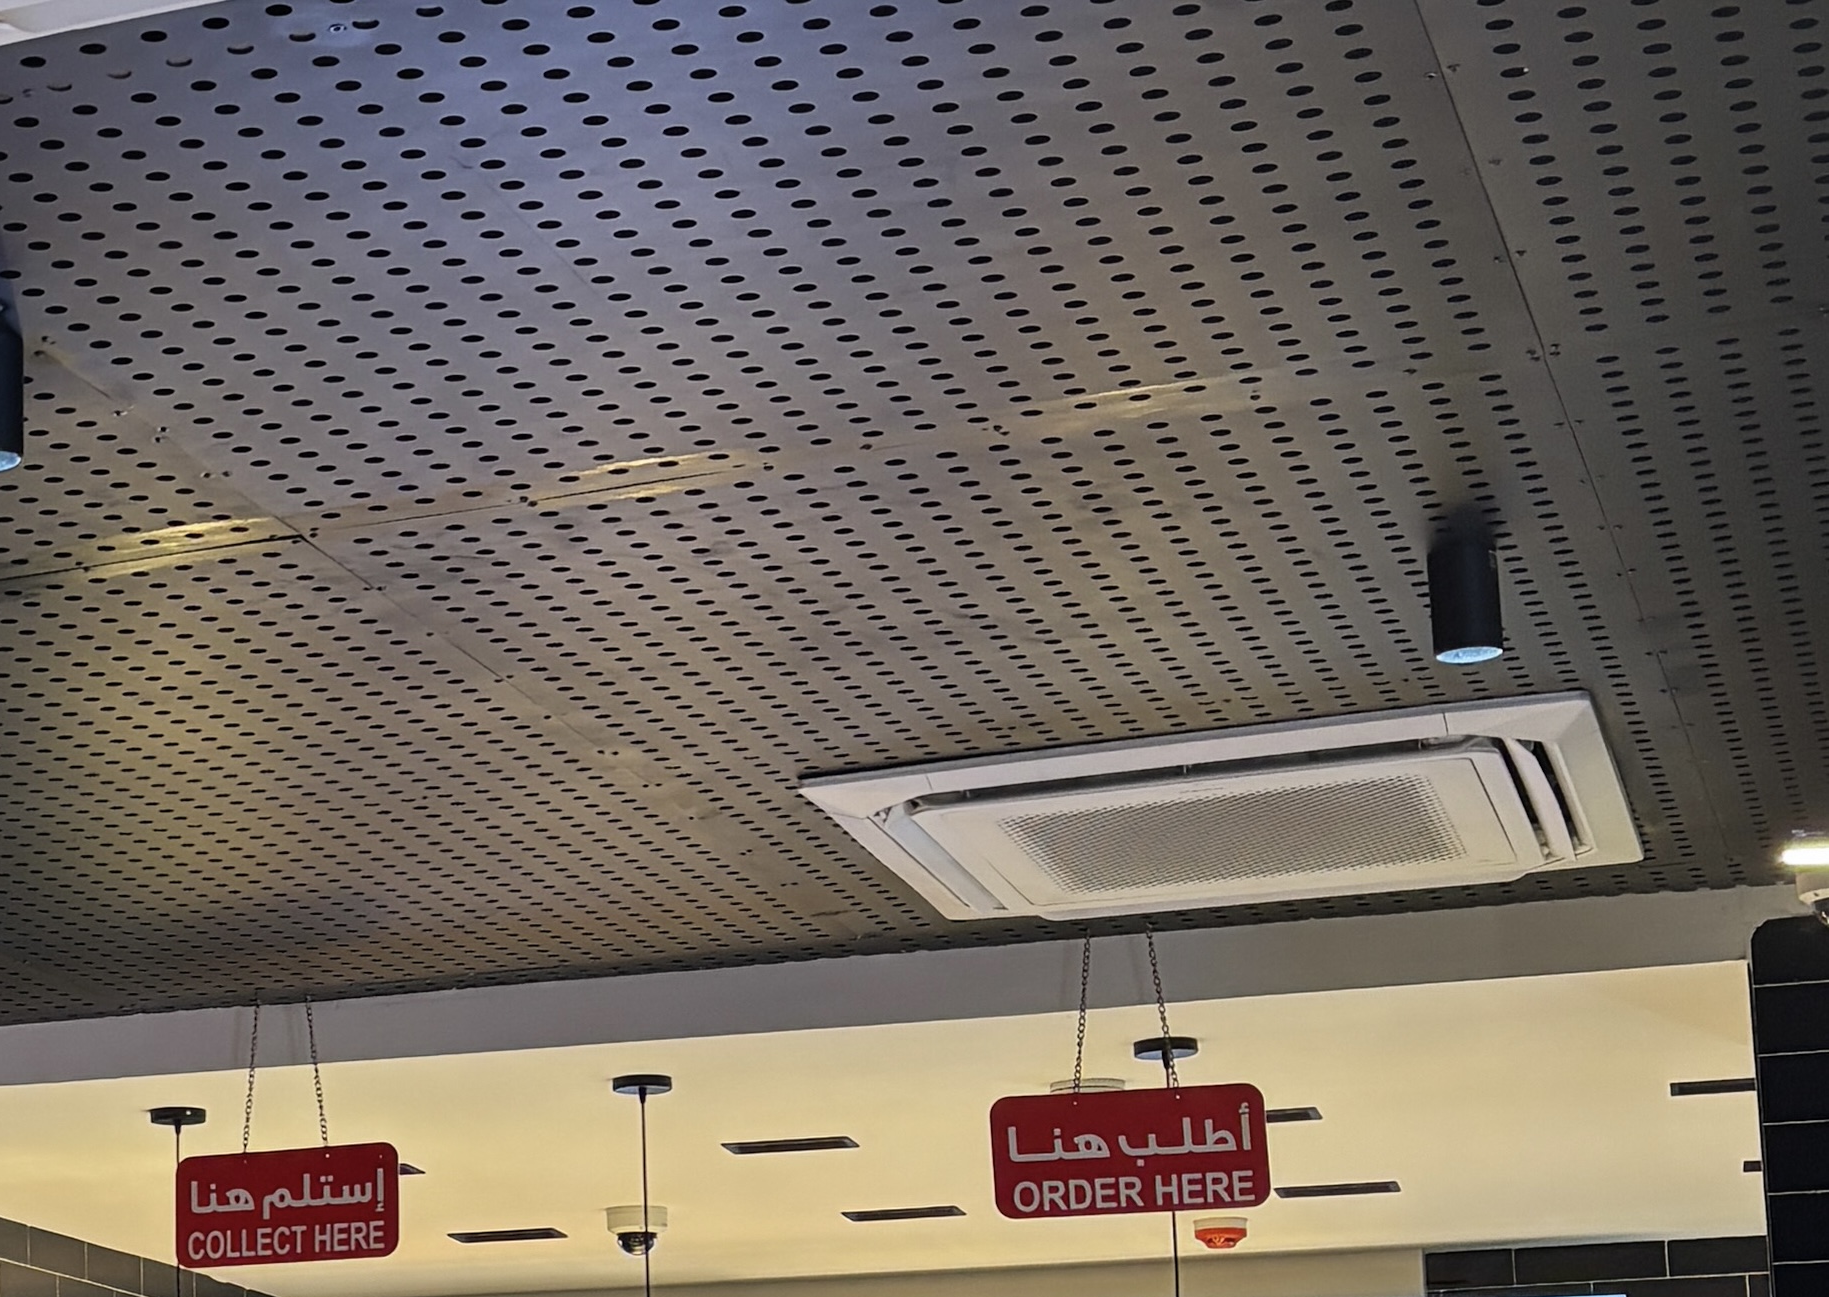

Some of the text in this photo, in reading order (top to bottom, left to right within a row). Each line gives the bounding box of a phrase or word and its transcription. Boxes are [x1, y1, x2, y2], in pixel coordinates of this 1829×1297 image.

[1007, 1102, 1252, 1167] أطلب هنا
[190, 1168, 385, 1219] إستلم هنا
[1013, 1170, 1256, 1213] ORDER HERE
[188, 1220, 385, 1260] COLLECT HERE
